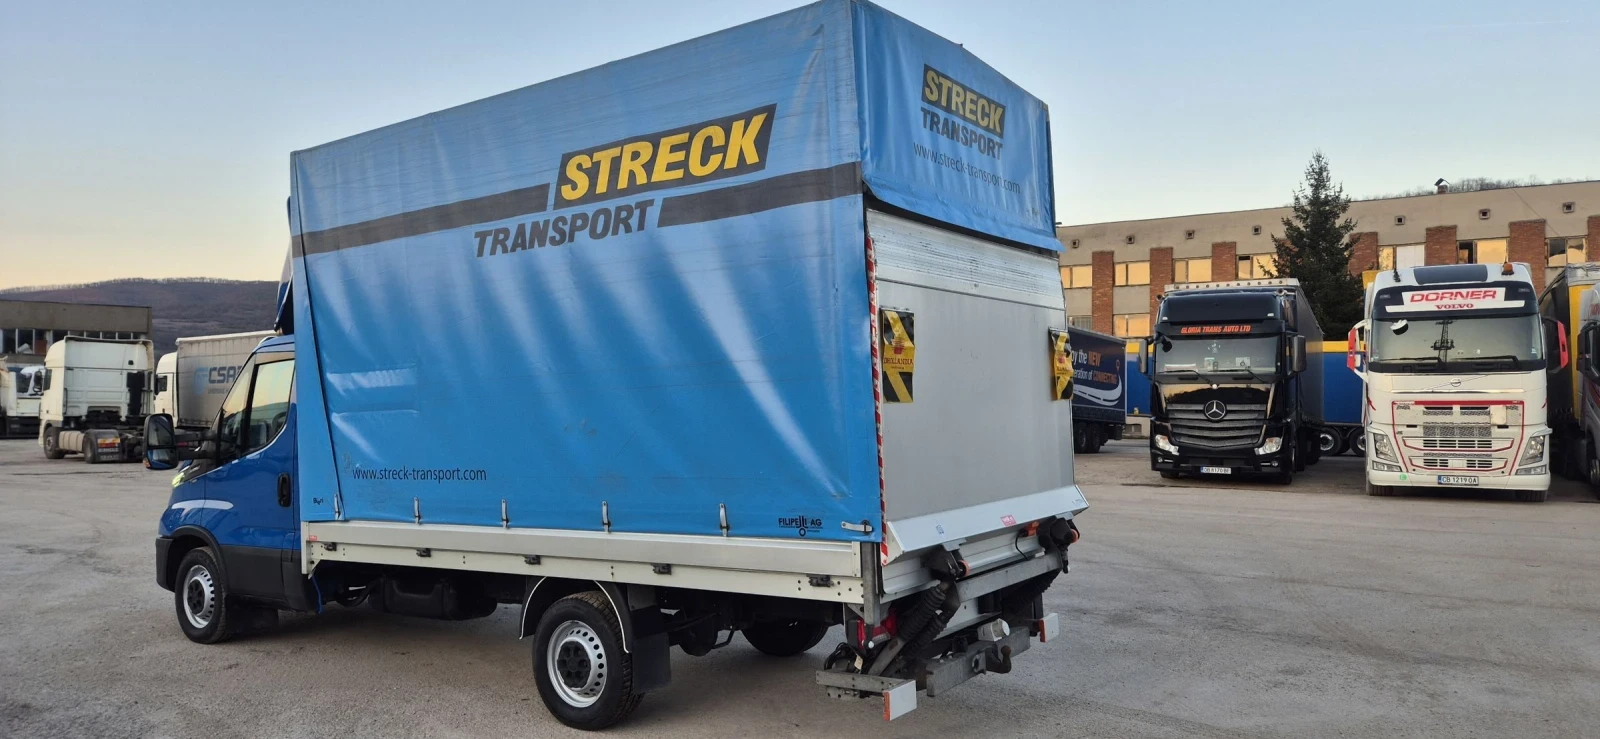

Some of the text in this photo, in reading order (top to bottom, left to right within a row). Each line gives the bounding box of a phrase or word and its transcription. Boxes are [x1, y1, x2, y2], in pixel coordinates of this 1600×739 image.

[925, 70, 1003, 133] STRECK
[560, 112, 768, 201] STRECK
[922, 106, 1003, 160] TRANSPORT
[914, 142, 1021, 194] www.streck-transport.com
[473, 198, 655, 258] TRANSPORT
[1410, 290, 1497, 303] DORNER
[1079, 349, 1088, 365] the
[1088, 351, 1102, 367] NEW
[352, 465, 487, 485] www.streck-transport.com
[810, 518, 822, 527] AG
